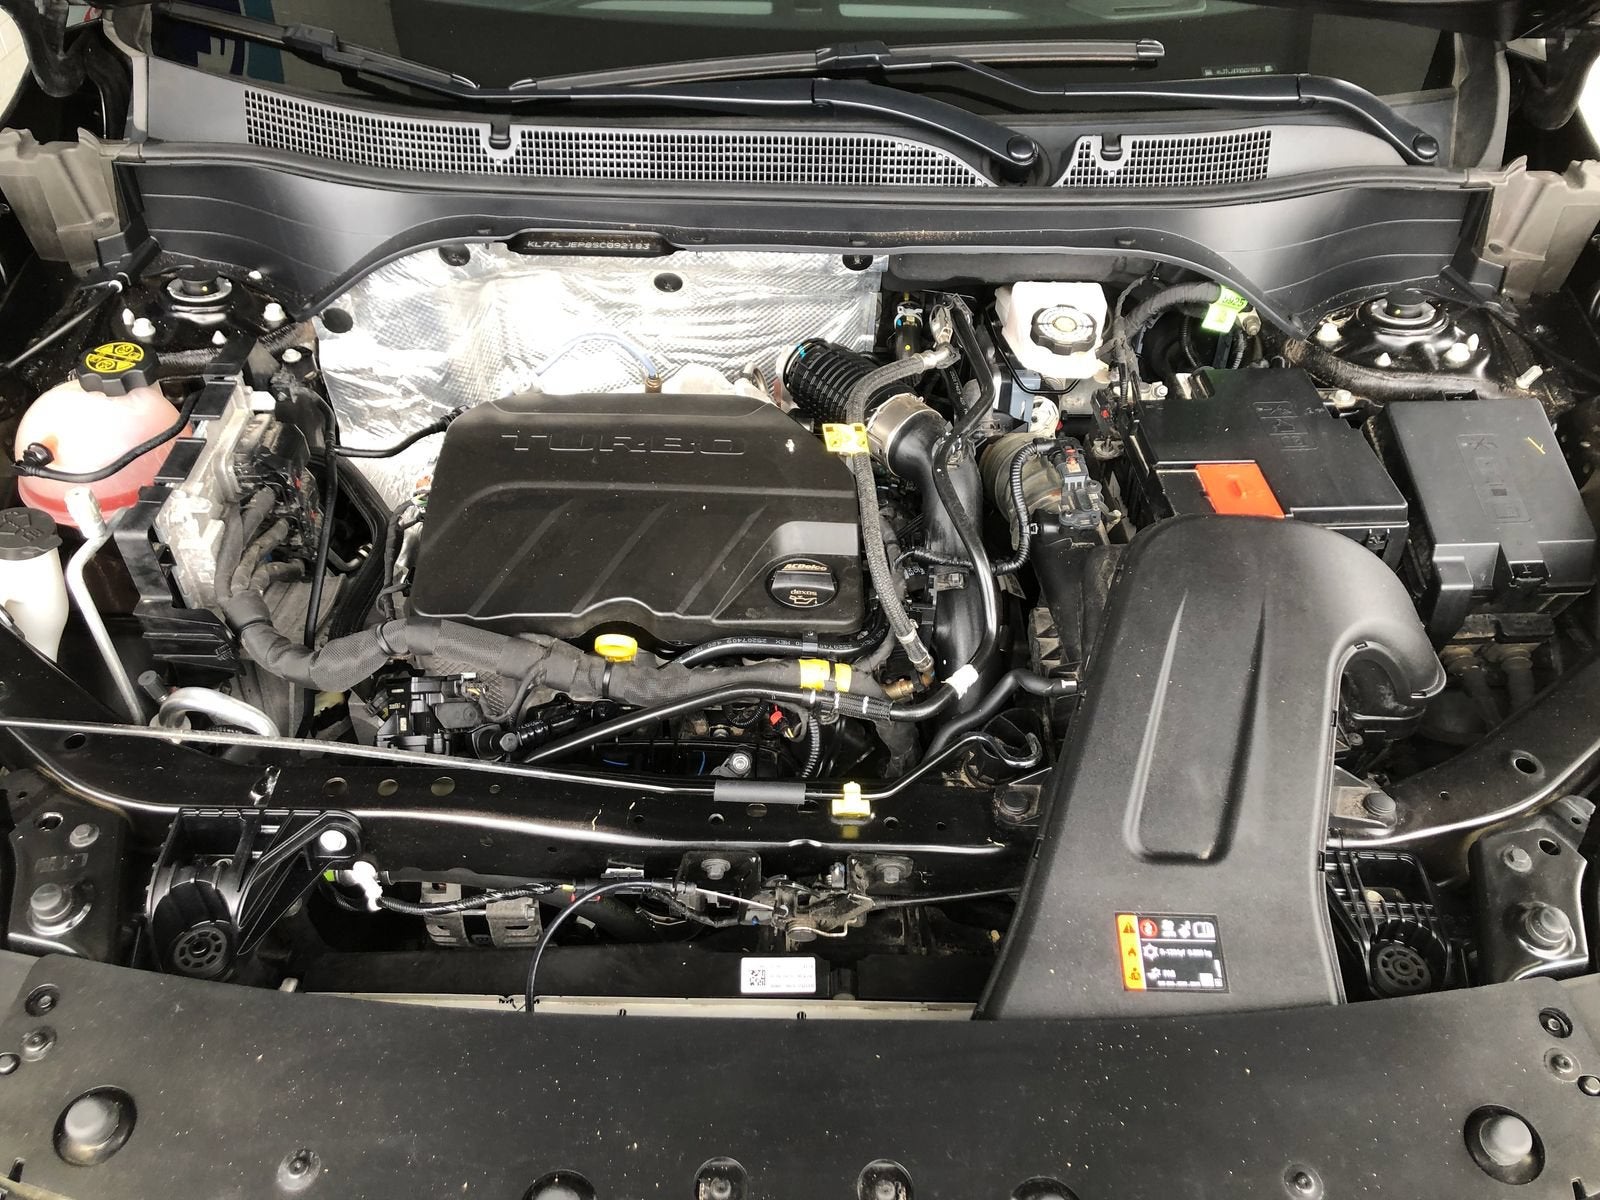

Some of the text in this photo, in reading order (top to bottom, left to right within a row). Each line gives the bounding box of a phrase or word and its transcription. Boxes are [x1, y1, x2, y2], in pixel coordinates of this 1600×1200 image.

[500, 434, 745, 455] TURBO
[781, 563, 828, 571] ACDelco
[790, 588, 818, 596] dexos
